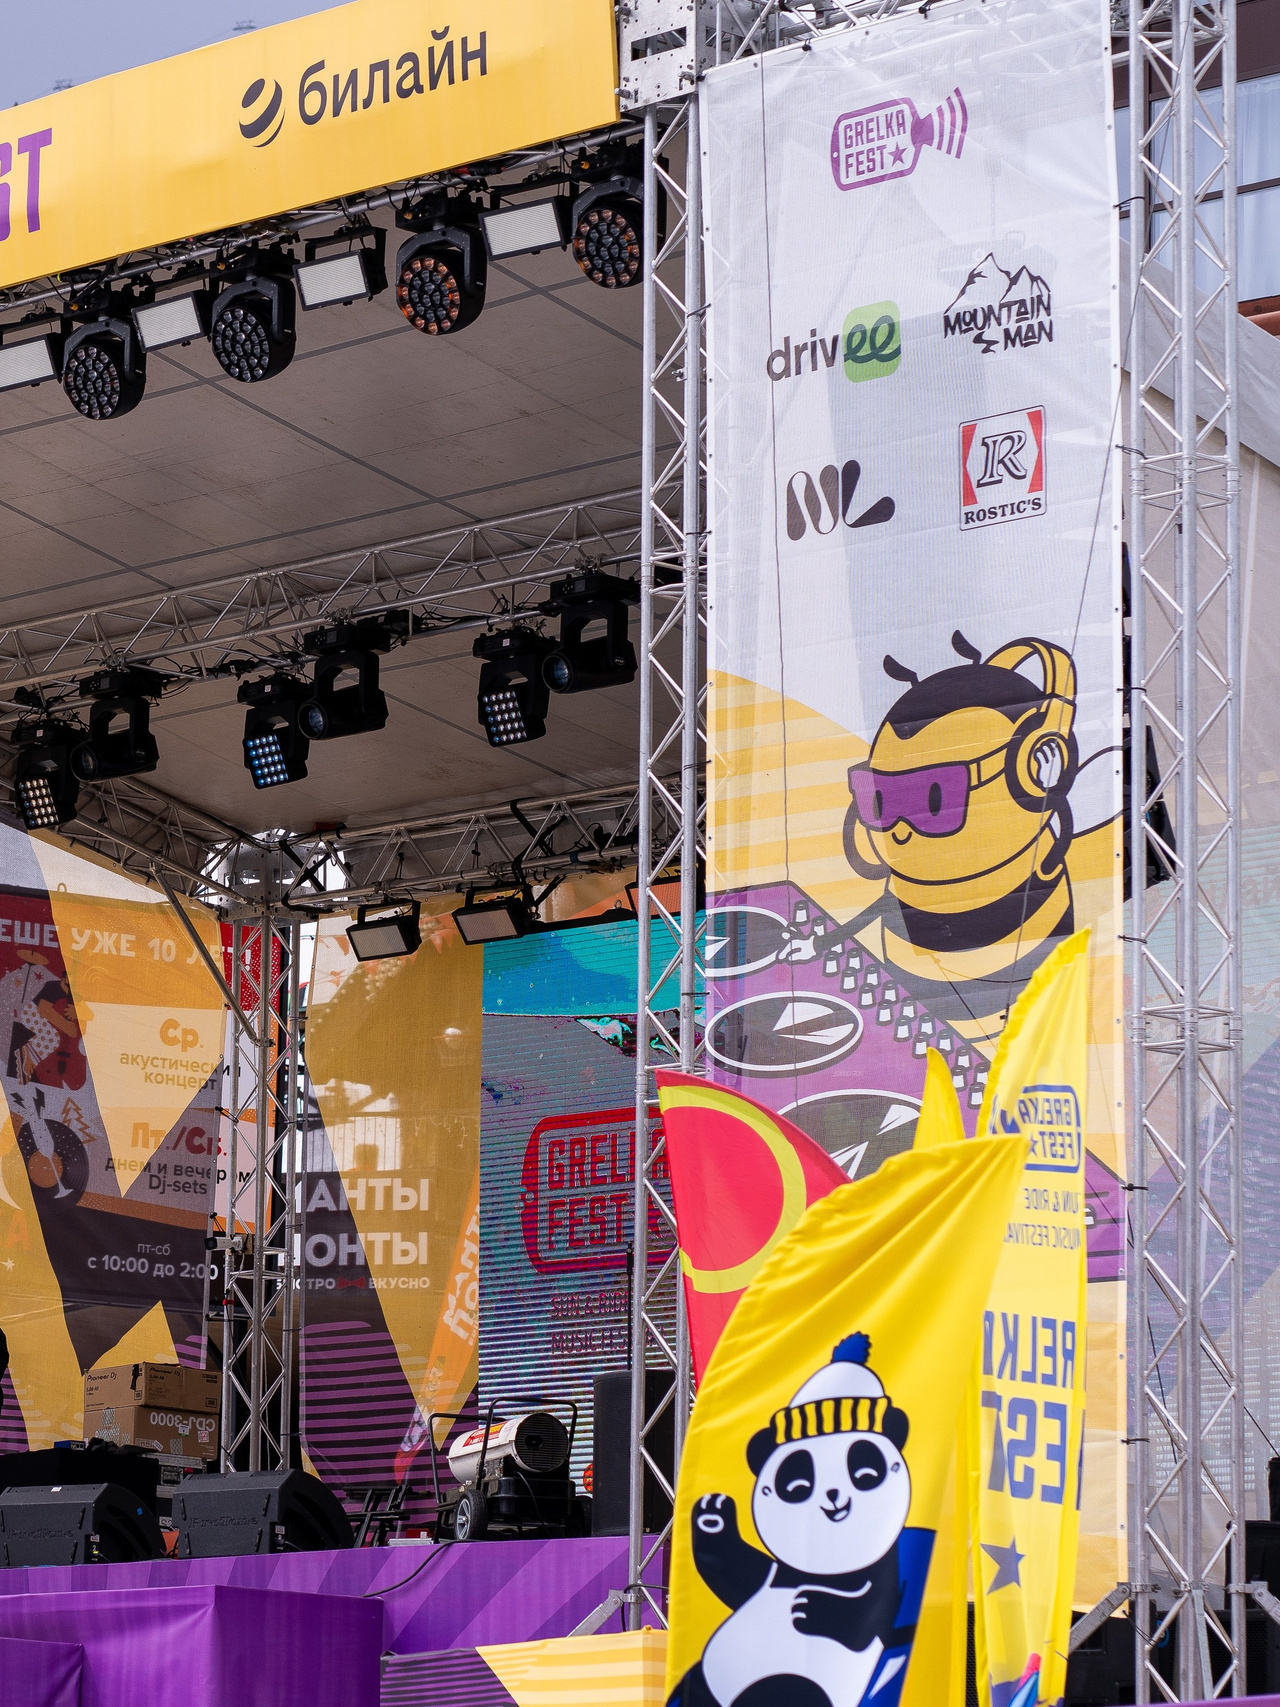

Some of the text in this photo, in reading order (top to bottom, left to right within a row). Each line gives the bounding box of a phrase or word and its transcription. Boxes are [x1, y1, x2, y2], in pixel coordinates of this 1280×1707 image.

[298, 25, 487, 126] билайн
[844, 109, 906, 149] GRELKA
[845, 144, 886, 179] FEST
[943, 290, 1051, 339] MOUNTAIN
[766, 314, 901, 381] drivee
[1003, 319, 1053, 351] MAN
[964, 497, 1043, 525] ROSTIC'S
[71, 927, 136, 958] УЖЕ
[149, 938, 177, 963] 10
[159, 1018, 204, 1053] Ср.
[144, 1070, 218, 1092] концерт
[105, 1157, 151, 1174] днем
[157, 1162, 168, 1175] и
[148, 1174, 208, 1196] Dj-sets
[295, 1178, 429, 1213] АНТЫ
[548, 1192, 630, 1250] FEST
[294, 1232, 428, 1267] ОНТЫ
[102, 1254, 149, 1274] 10:00
[153, 1263, 175, 1278] до
[179, 1262, 219, 1281] 2:00
[368, 1276, 430, 1290] ВКУСНО
[87, 1374, 110, 1382] Pioneer
[150, 1411, 216, 1432] CDJ-3000
